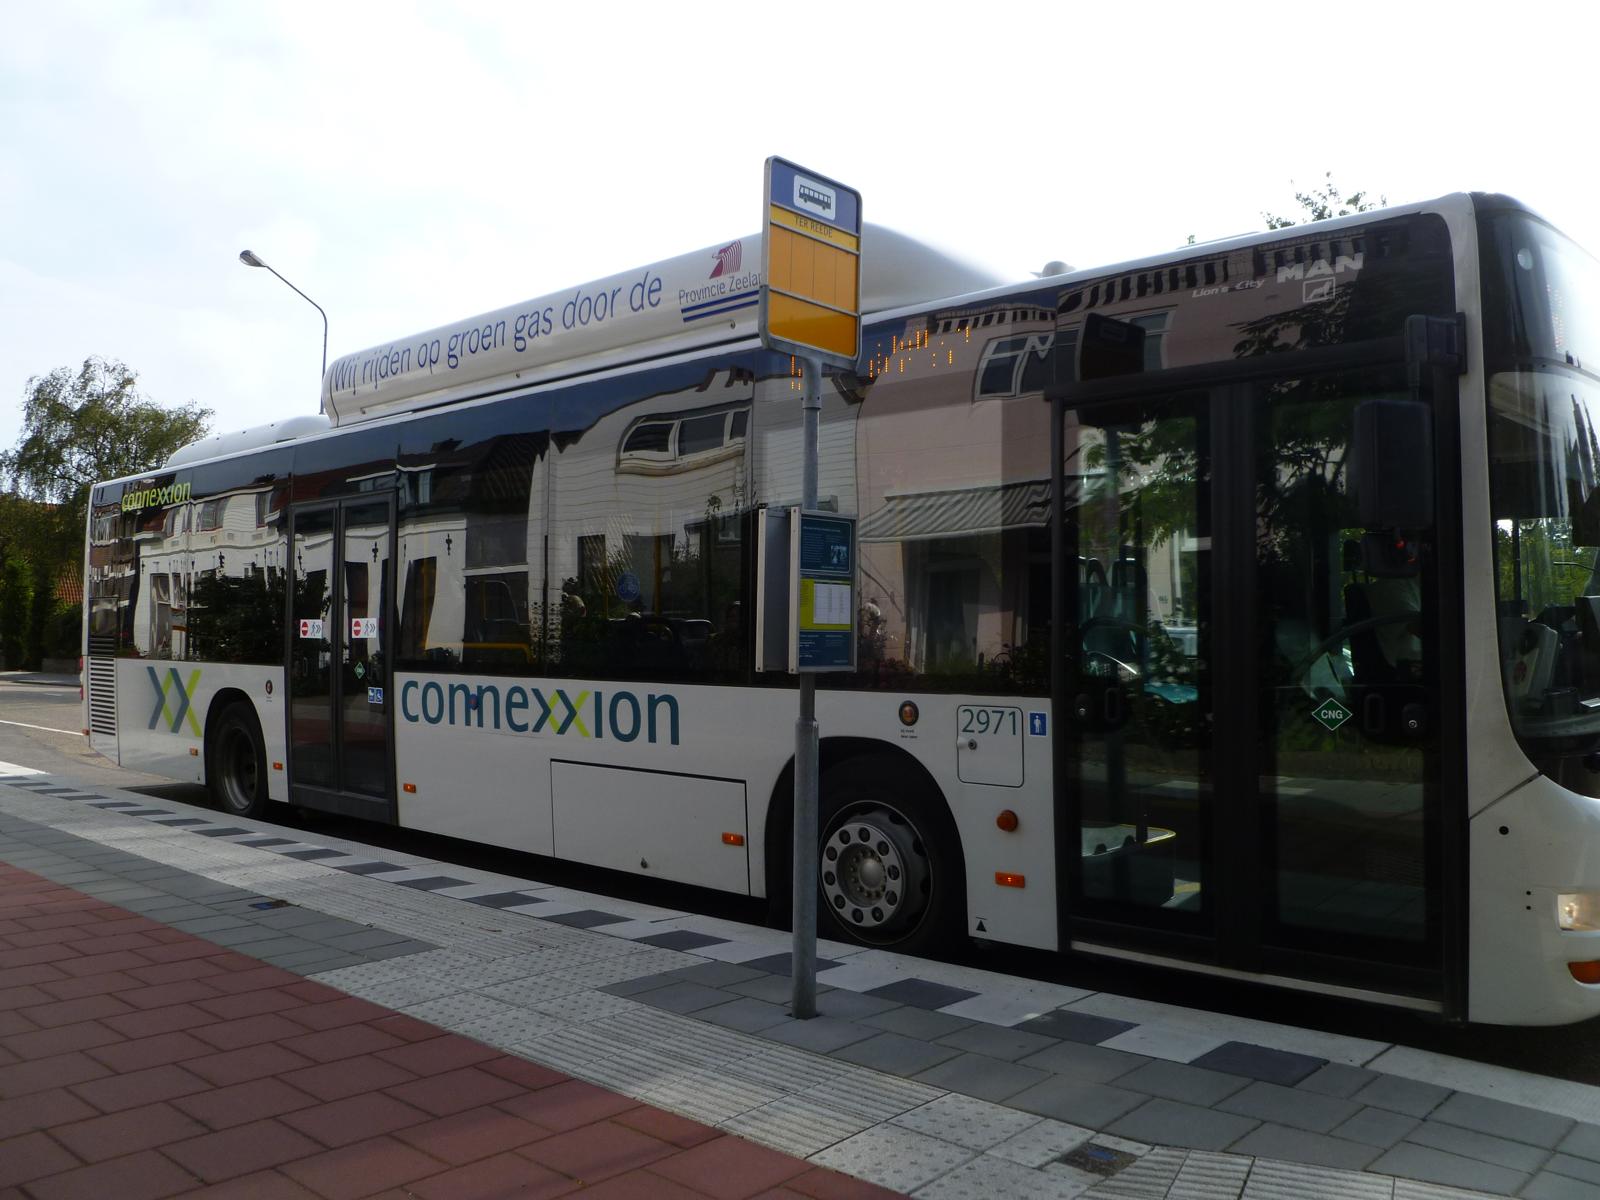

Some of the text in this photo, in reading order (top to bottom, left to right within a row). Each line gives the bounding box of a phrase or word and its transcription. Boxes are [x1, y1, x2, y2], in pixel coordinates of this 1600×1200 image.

[793, 214, 833, 238] TER REEDE
[1276, 252, 1364, 283] MAN
[678, 280, 726, 305] Provincie
[1192, 278, 1264, 298] Lion's City
[334, 271, 662, 396] Wij rijden op groen gas door de
[122, 482, 191, 512] connexxion
[401, 680, 680, 746] connexxion
[961, 708, 1017, 735] 2971
[1320, 709, 1344, 719] CNG
